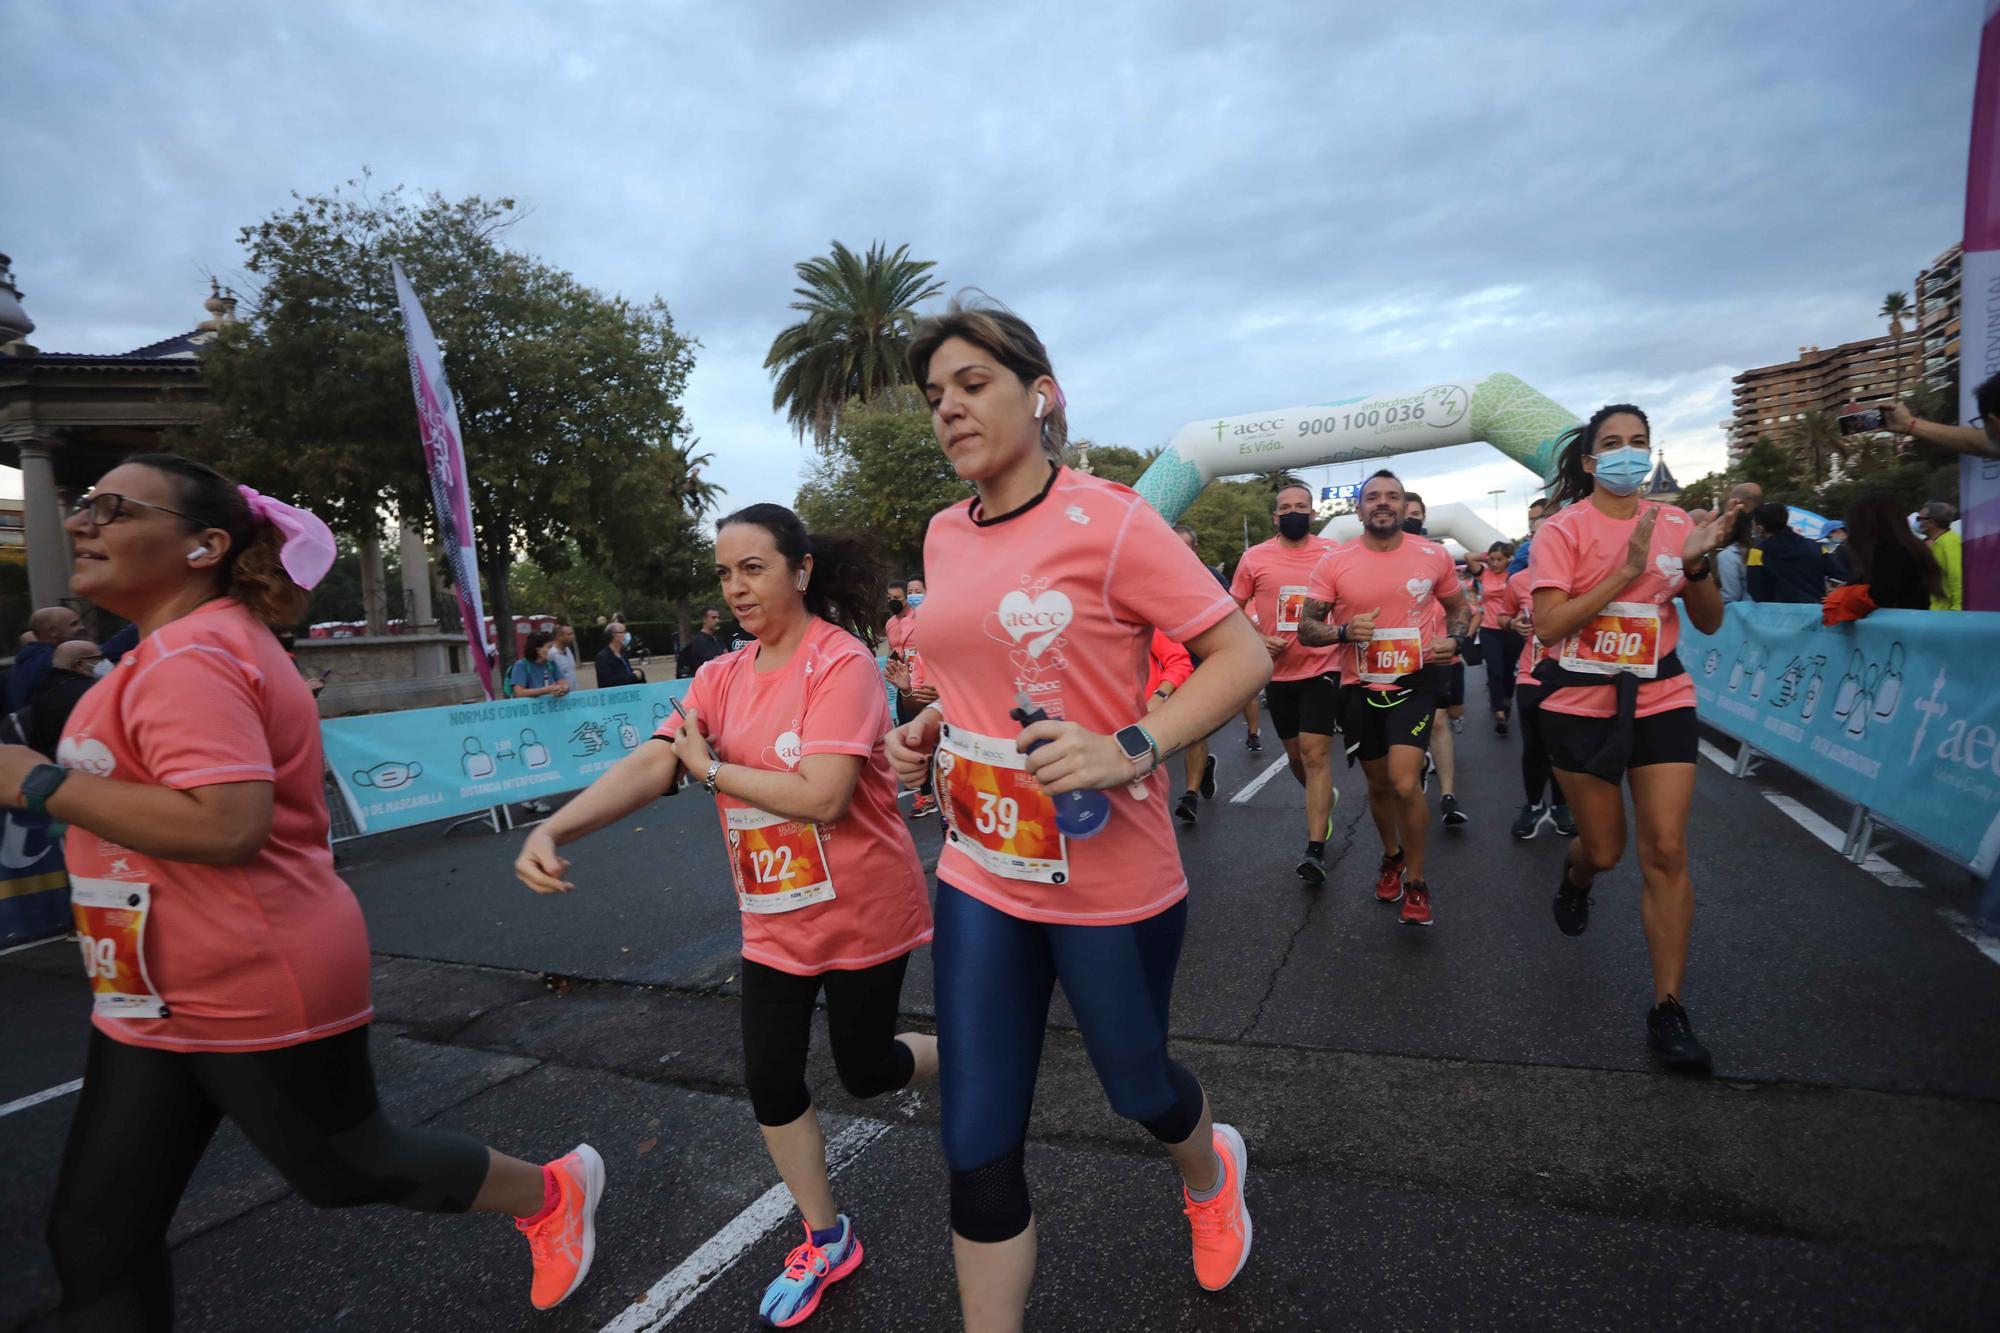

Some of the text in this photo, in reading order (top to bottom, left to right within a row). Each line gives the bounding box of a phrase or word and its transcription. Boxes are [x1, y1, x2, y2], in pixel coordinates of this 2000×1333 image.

[1233, 418, 1285, 436] aecc
[1298, 402, 1425, 438] 900 100 036
[1239, 443, 1252, 455] Es
[1005, 610, 1065, 627] aecc
[1593, 630, 1643, 656] 1610
[1376, 649, 1409, 669] 1614
[450, 706, 495, 726] NORMAS
[498, 700, 530, 718] COVID
[532, 702, 545, 715] DE
[601, 693, 606, 706] E
[608, 689, 643, 704] HIGIENE
[460, 781, 502, 799] DISTANCIA
[370, 803, 385, 816] DE
[386, 791, 445, 813] MASCARILLA
[975, 791, 1020, 840] 39
[749, 845, 796, 884] 122
[76, 930, 118, 980] 09
